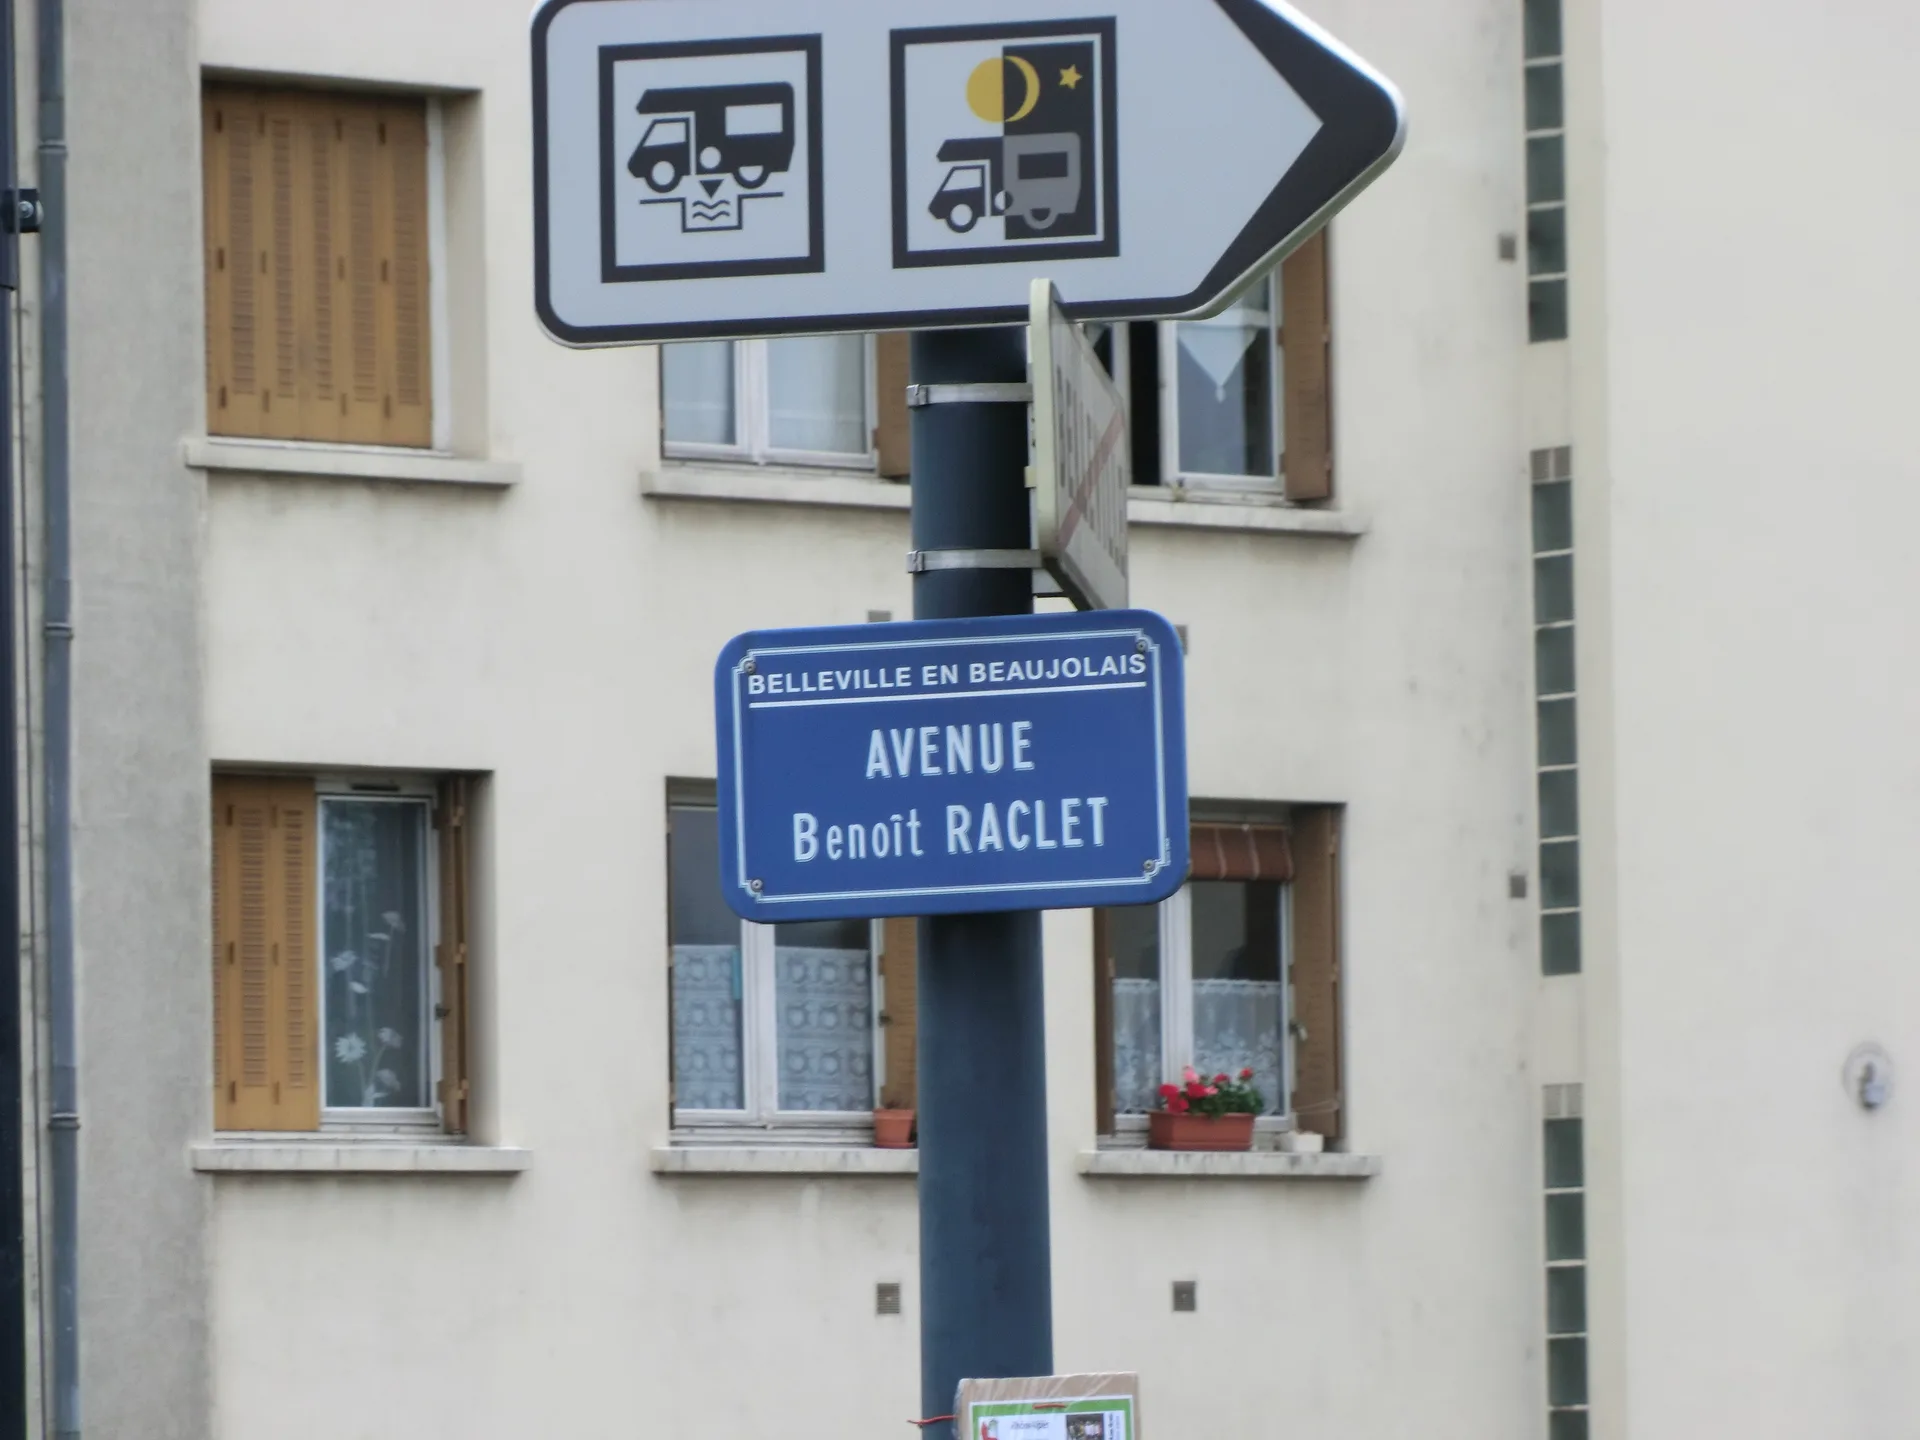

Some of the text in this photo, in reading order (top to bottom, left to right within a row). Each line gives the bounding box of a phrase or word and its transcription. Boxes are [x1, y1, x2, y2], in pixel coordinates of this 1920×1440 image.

[748, 653, 1147, 696] BELLEVILLE EN BEAUJOLAIS
[866, 720, 1036, 780] AVENUE
[793, 809, 925, 864] Benoît
[945, 796, 1109, 856] RACLET
